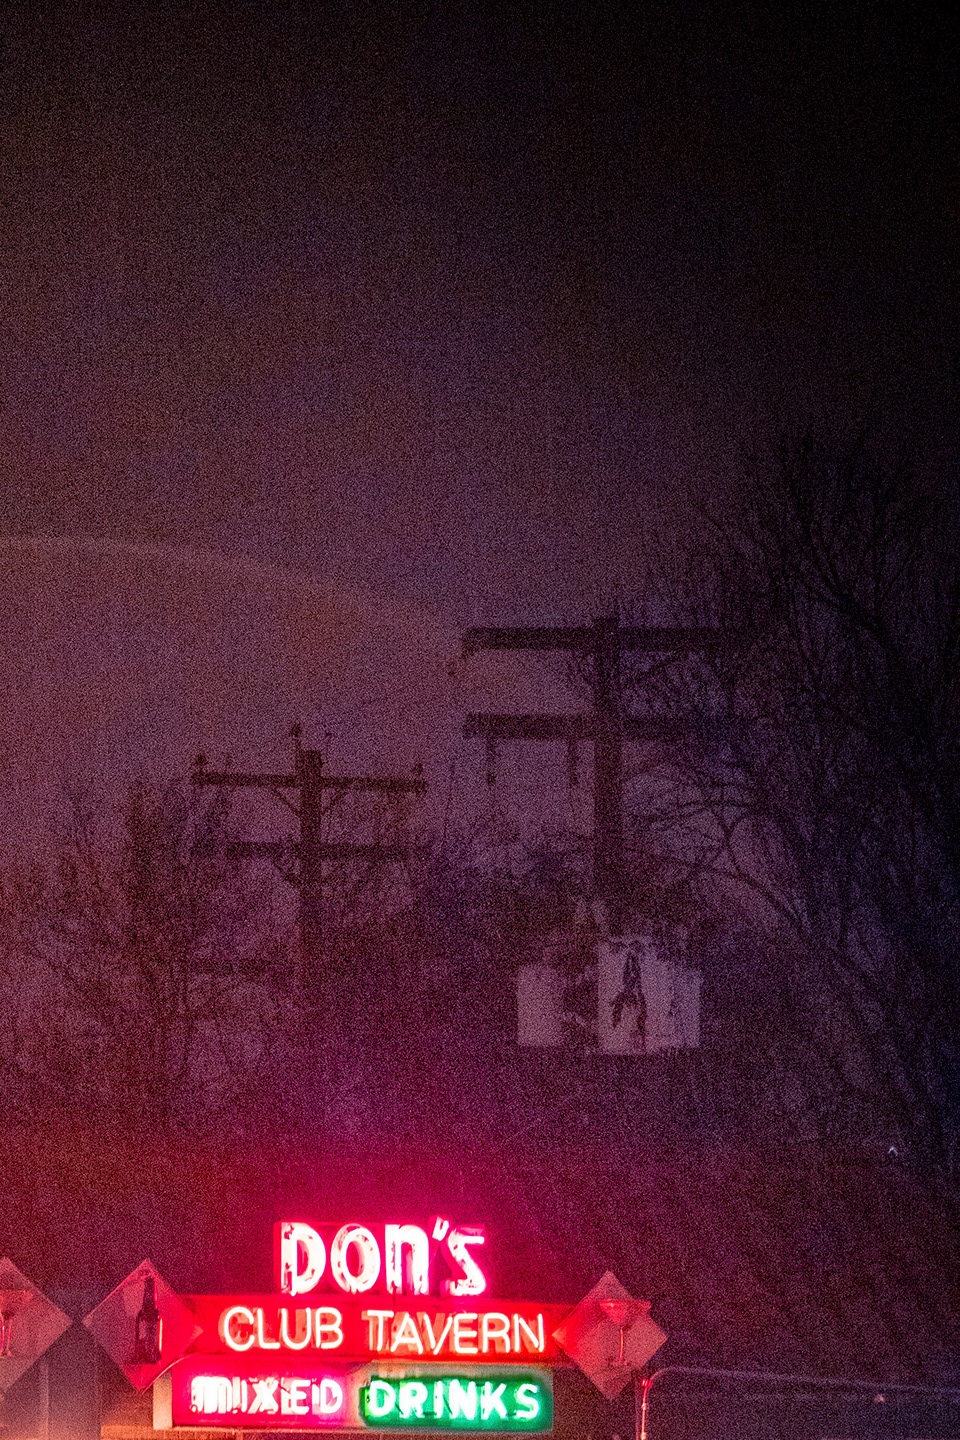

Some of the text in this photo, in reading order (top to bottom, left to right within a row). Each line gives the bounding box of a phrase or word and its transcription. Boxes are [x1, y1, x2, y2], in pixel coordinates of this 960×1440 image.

[281, 1217, 488, 1297] DON'S
[221, 1305, 545, 1354] CLUB TAVERN
[190, 1375, 541, 1420] MIXED DRINKS
